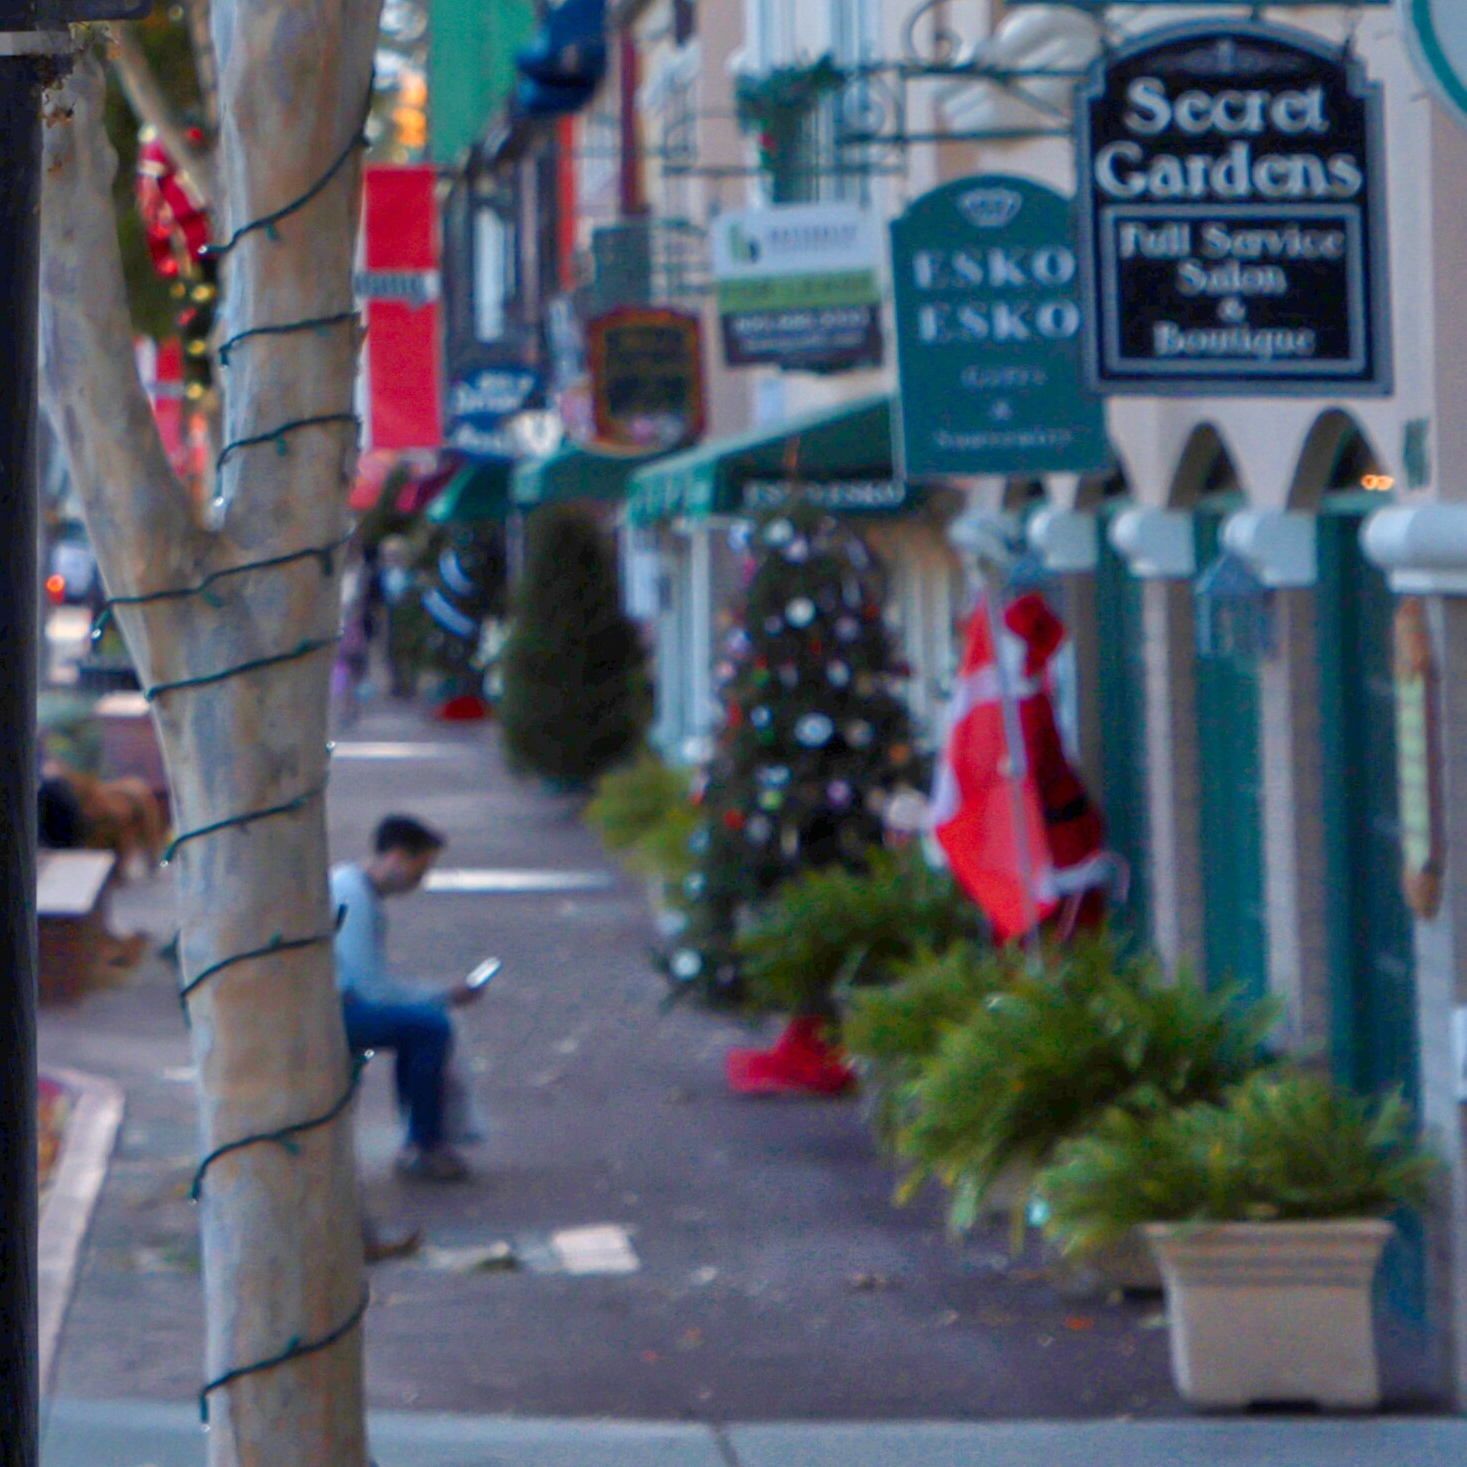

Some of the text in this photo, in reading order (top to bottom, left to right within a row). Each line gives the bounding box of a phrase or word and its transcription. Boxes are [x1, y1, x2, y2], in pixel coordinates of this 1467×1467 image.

[1123, 76, 1330, 135] Secret
[1094, 139, 1363, 199] Gardens
[1118, 221, 1347, 259] Full Service
[1175, 257, 1289, 297] Salon
[1215, 297, 1246, 324] &
[1153, 320, 1318, 361] Boutique
